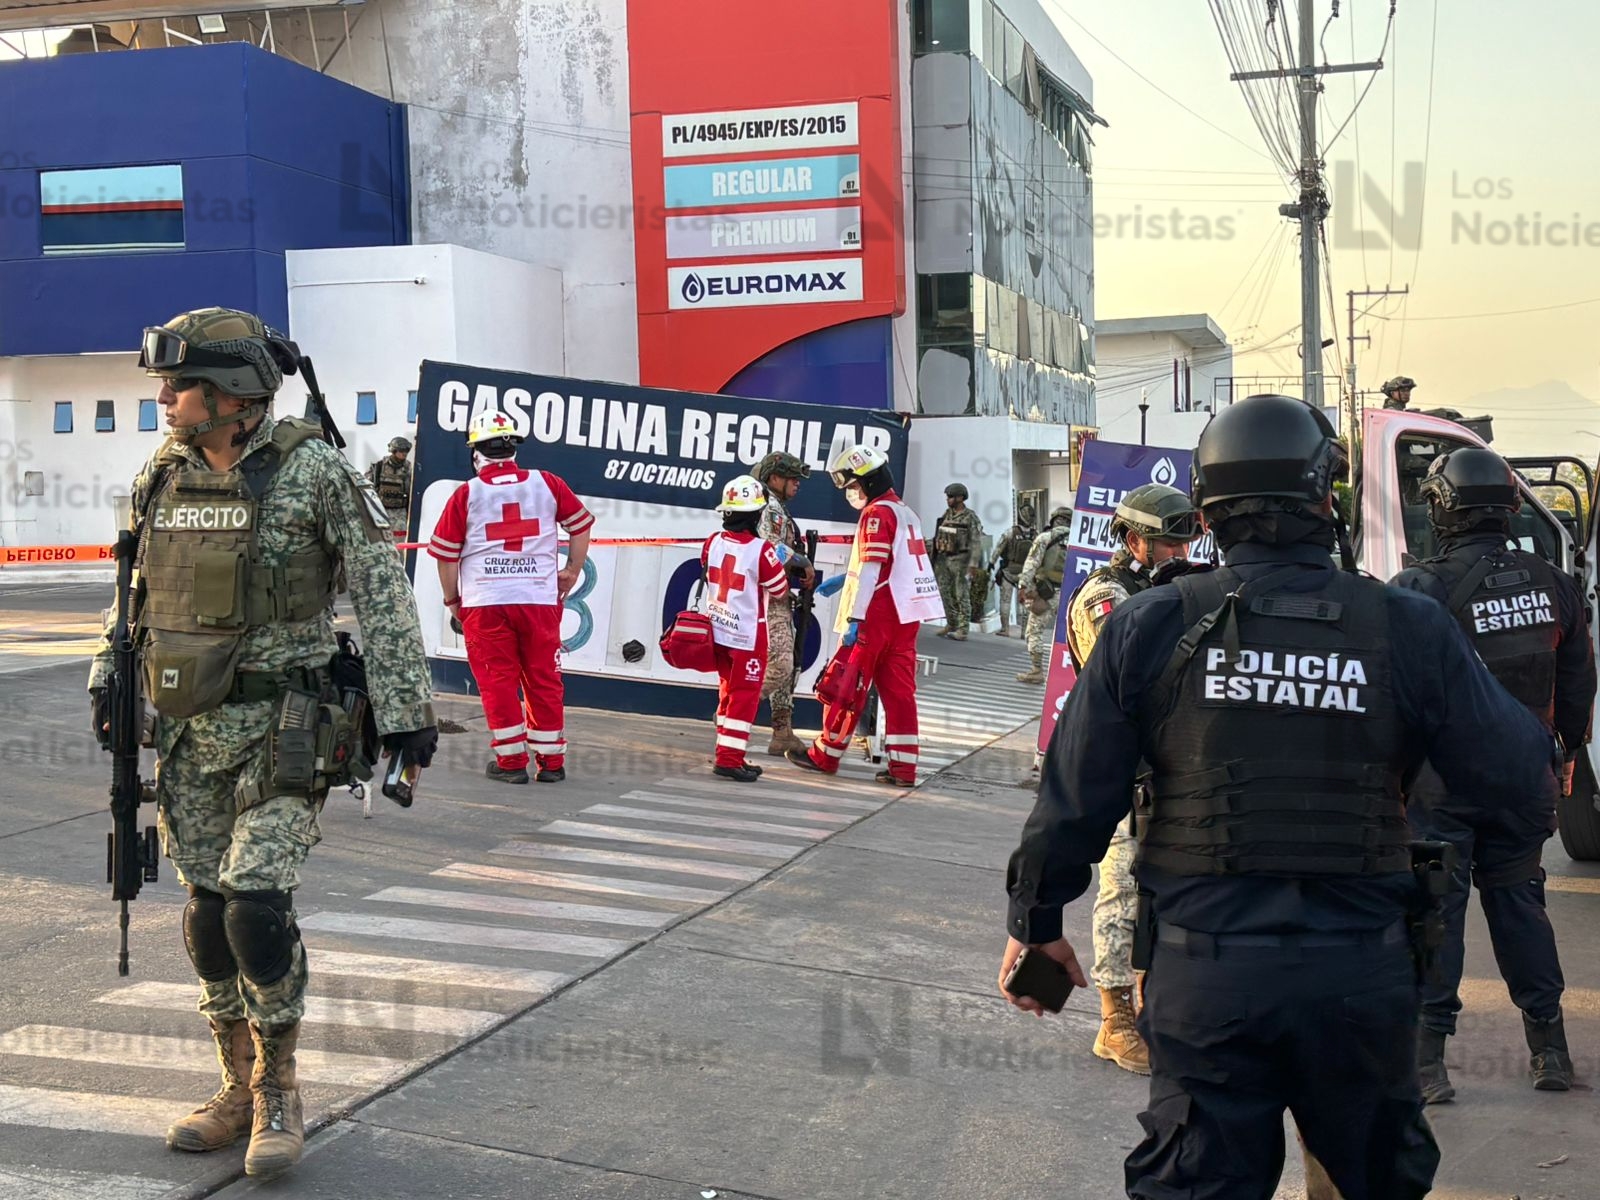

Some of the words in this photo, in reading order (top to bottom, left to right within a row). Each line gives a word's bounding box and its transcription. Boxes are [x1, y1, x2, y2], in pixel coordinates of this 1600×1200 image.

[672, 115, 846, 144] PL/4945/EXP/ES/2015
[712, 166, 812, 197] REGULAR
[711, 217, 817, 248] PREMIUM
[847, 231, 856, 240] 91
[706, 271, 847, 296] EUROMAX
[437, 380, 669, 456] GASOLINA
[679, 407, 892, 472] REGULAR
[604, 459, 626, 480] 87
[629, 462, 717, 490] OCTANOS
[742, 487, 750, 498] 5
[153, 504, 247, 528] EJÉRCITO
[484, 557, 511, 566] CRUZ
[512, 557, 537, 566] ROJA
[484, 566, 538, 575] MEXICANA
[1471, 590, 1552, 618] POLICÍA
[1474, 608, 1555, 633] ESTATAL
[1206, 647, 1368, 685] POLICÍA
[1205, 675, 1367, 714] ESTATAL
